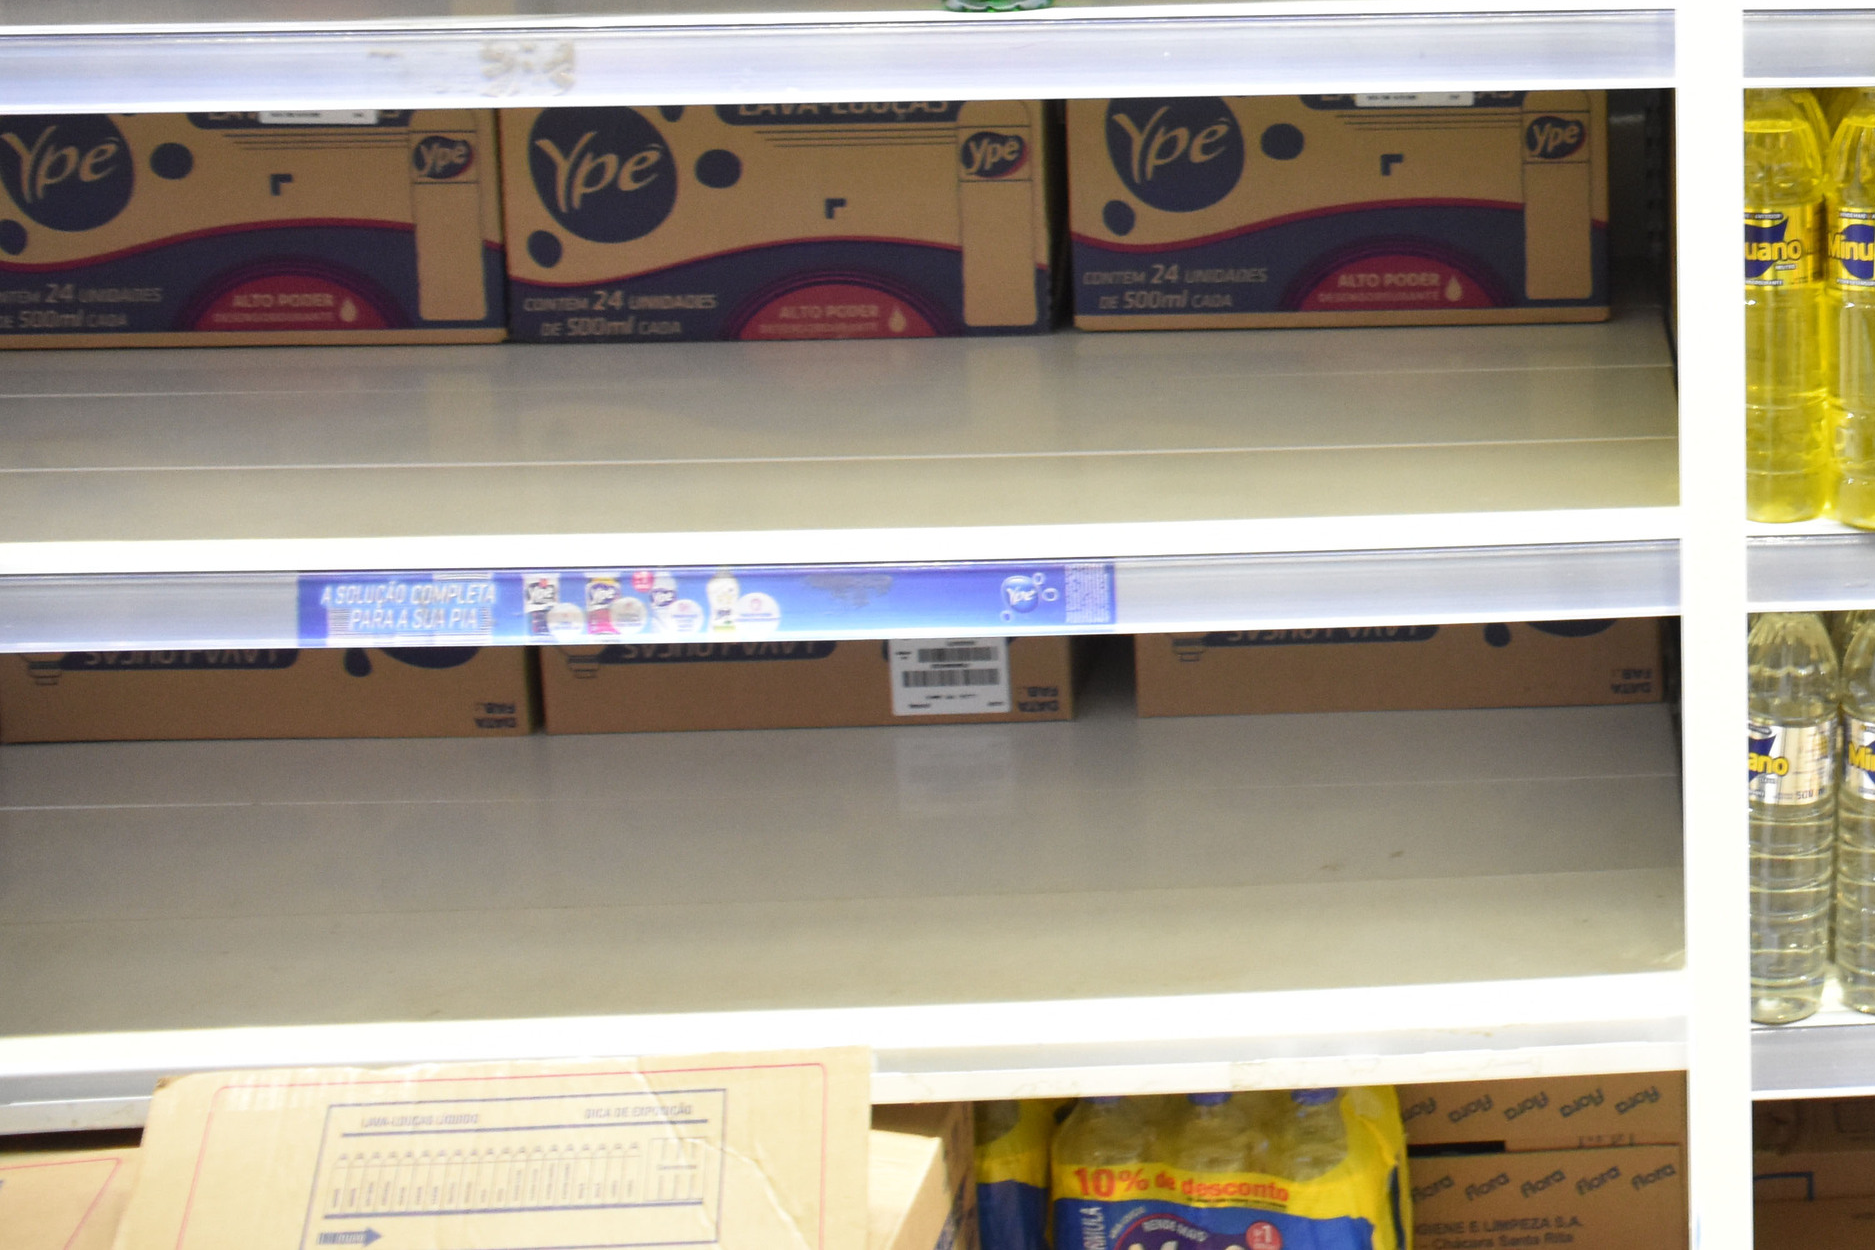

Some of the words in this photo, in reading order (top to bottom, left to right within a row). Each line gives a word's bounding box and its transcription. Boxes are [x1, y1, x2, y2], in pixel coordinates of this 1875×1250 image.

[1113, 106, 1230, 185] Ypê
[534, 130, 662, 214] Ypê
[1150, 264, 1179, 285] 24
[1184, 267, 1268, 284] UNIDADES
[1337, 273, 1379, 289] ALTO
[1383, 272, 1440, 288] PODER
[1099, 296, 1119, 310] DE
[1124, 289, 1188, 310] 500ml
[321, 586, 333, 605] A
[336, 580, 407, 607] SOLUÇÃO
[411, 582, 496, 606] COMPLETA
[349, 608, 393, 629] PARA
[396, 608, 410, 629] A
[414, 608, 445, 629] SUA
[449, 608, 478, 628] PIA
[1073, 1167, 1149, 1198] 10%
[1155, 1169, 1176, 1190] de
[1181, 1178, 1289, 1202] desconto
